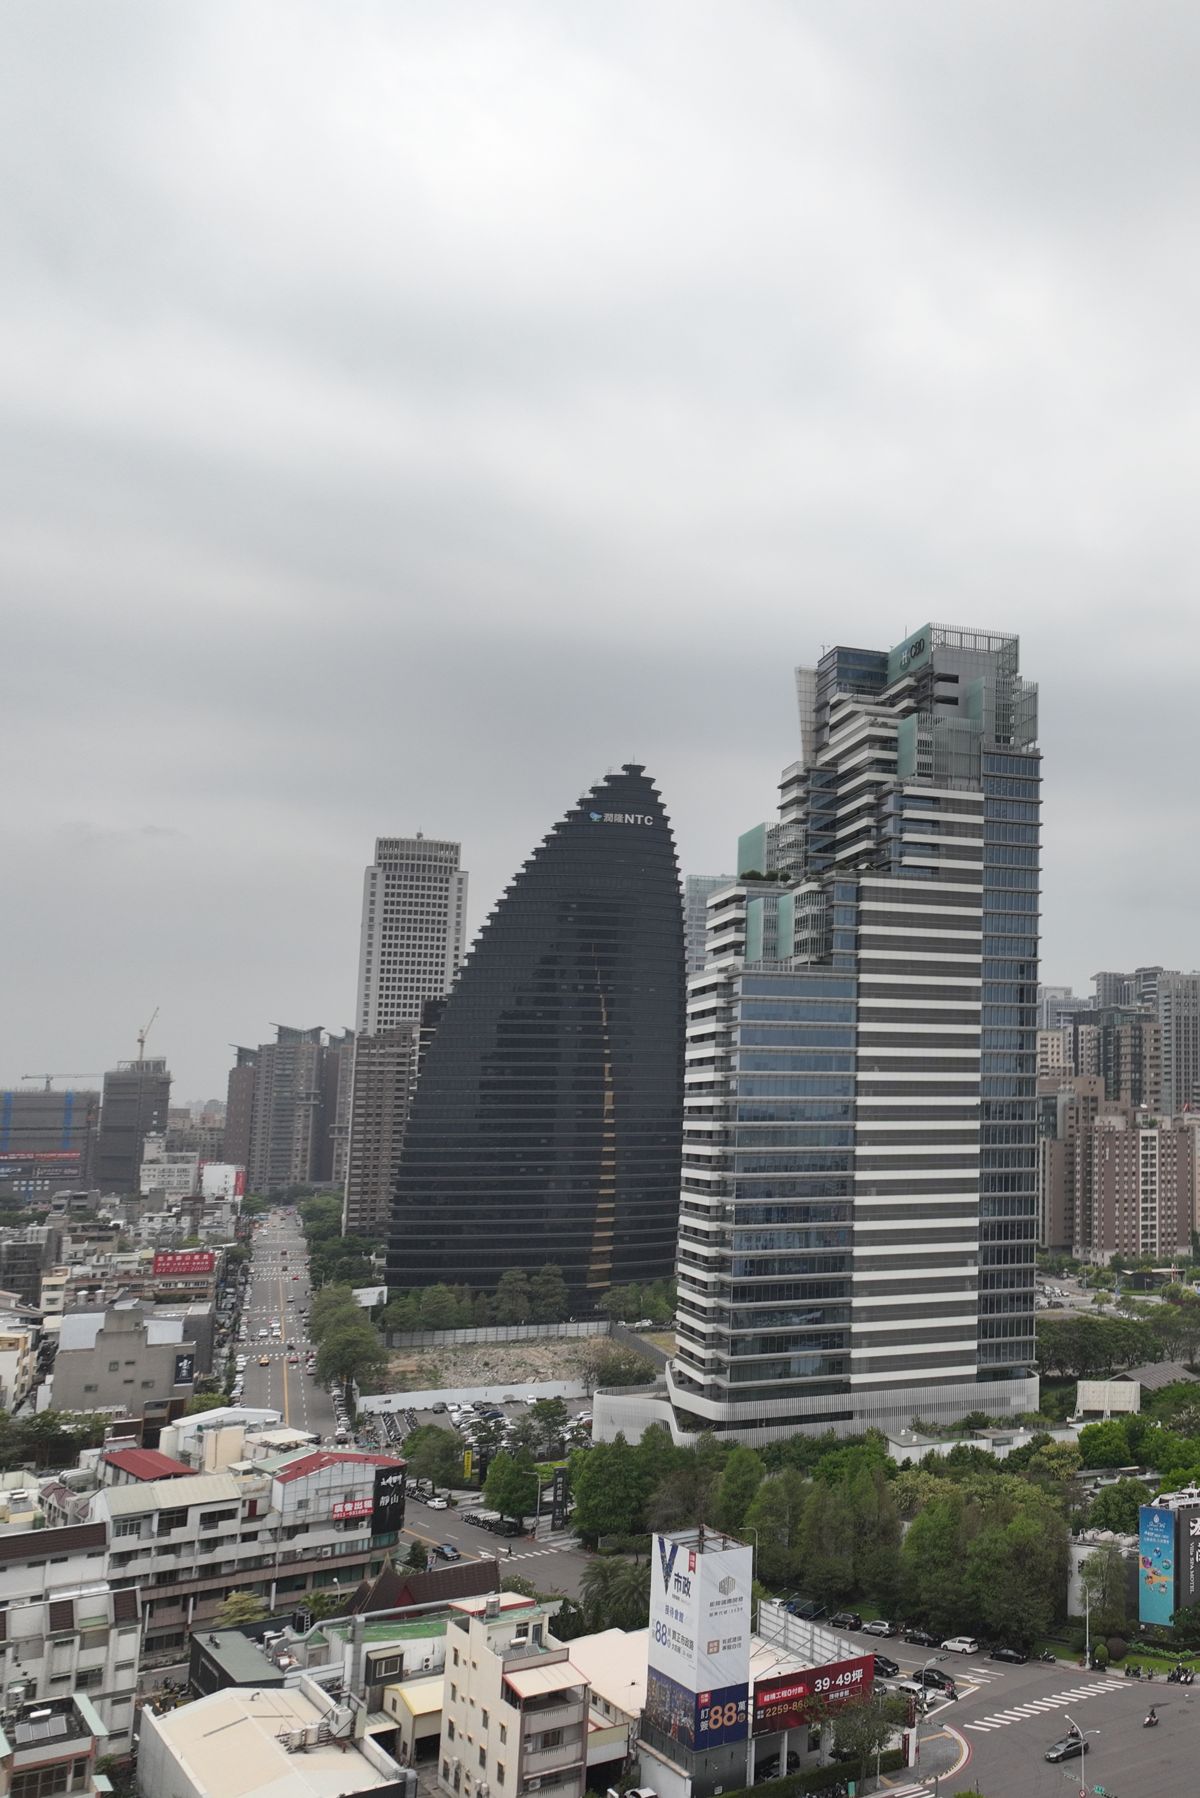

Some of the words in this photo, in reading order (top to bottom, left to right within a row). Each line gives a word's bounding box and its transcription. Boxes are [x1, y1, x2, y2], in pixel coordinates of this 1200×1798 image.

[333, 1499, 374, 1514] 廣告出租
[673, 1571, 692, 1599] 市政
[655, 1620, 668, 1646] 88
[708, 1702, 738, 1730] 88
